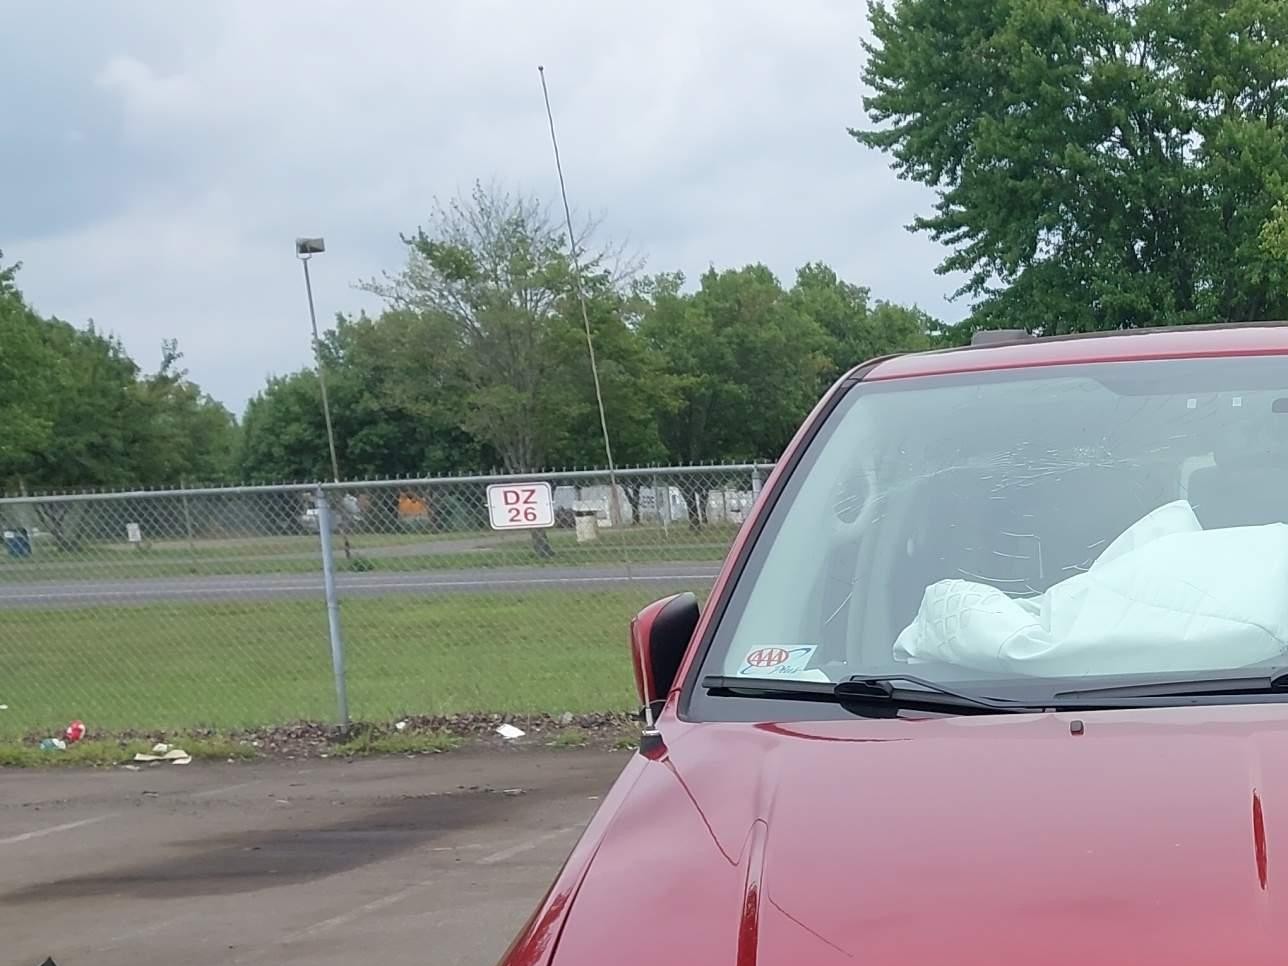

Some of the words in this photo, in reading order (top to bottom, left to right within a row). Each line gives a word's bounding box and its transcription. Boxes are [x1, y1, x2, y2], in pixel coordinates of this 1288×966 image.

[503, 489, 538, 505] DZ
[508, 506, 537, 522] 26
[749, 648, 785, 667] AAA
